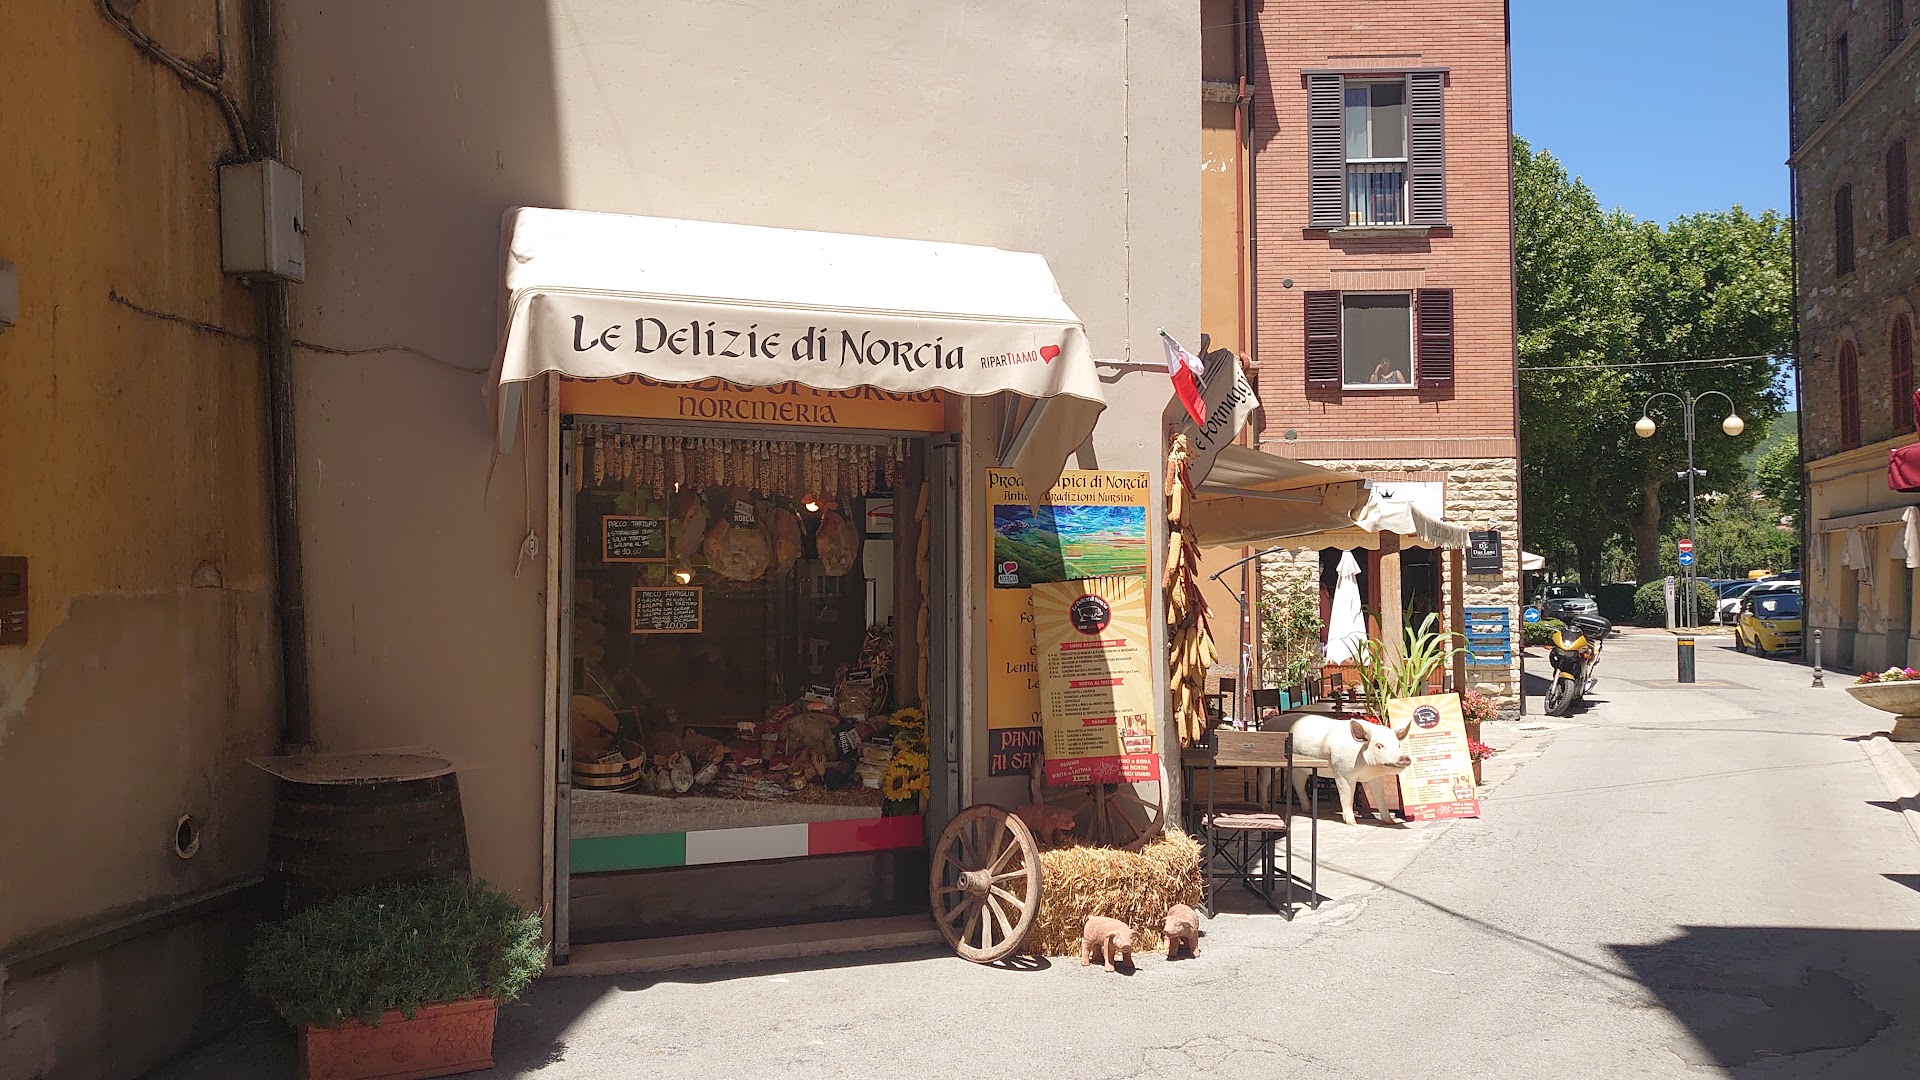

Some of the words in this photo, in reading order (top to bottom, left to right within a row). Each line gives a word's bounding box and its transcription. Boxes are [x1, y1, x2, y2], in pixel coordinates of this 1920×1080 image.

[571, 314, 622, 352] Le
[634, 317, 781, 359] Delizie
[791, 326, 828, 362] di
[839, 329, 964, 373] Norcia
[980, 350, 1038, 369] RIPARTIAMO
[1090, 474, 1103, 488] di
[1106, 475, 1148, 490] Norcia
[1098, 491, 1135, 503] Nursine
[608, 520, 628, 528] PACCO
[734, 514, 755, 523] NORCIA
[1060, 759, 1080, 769] PANINO
